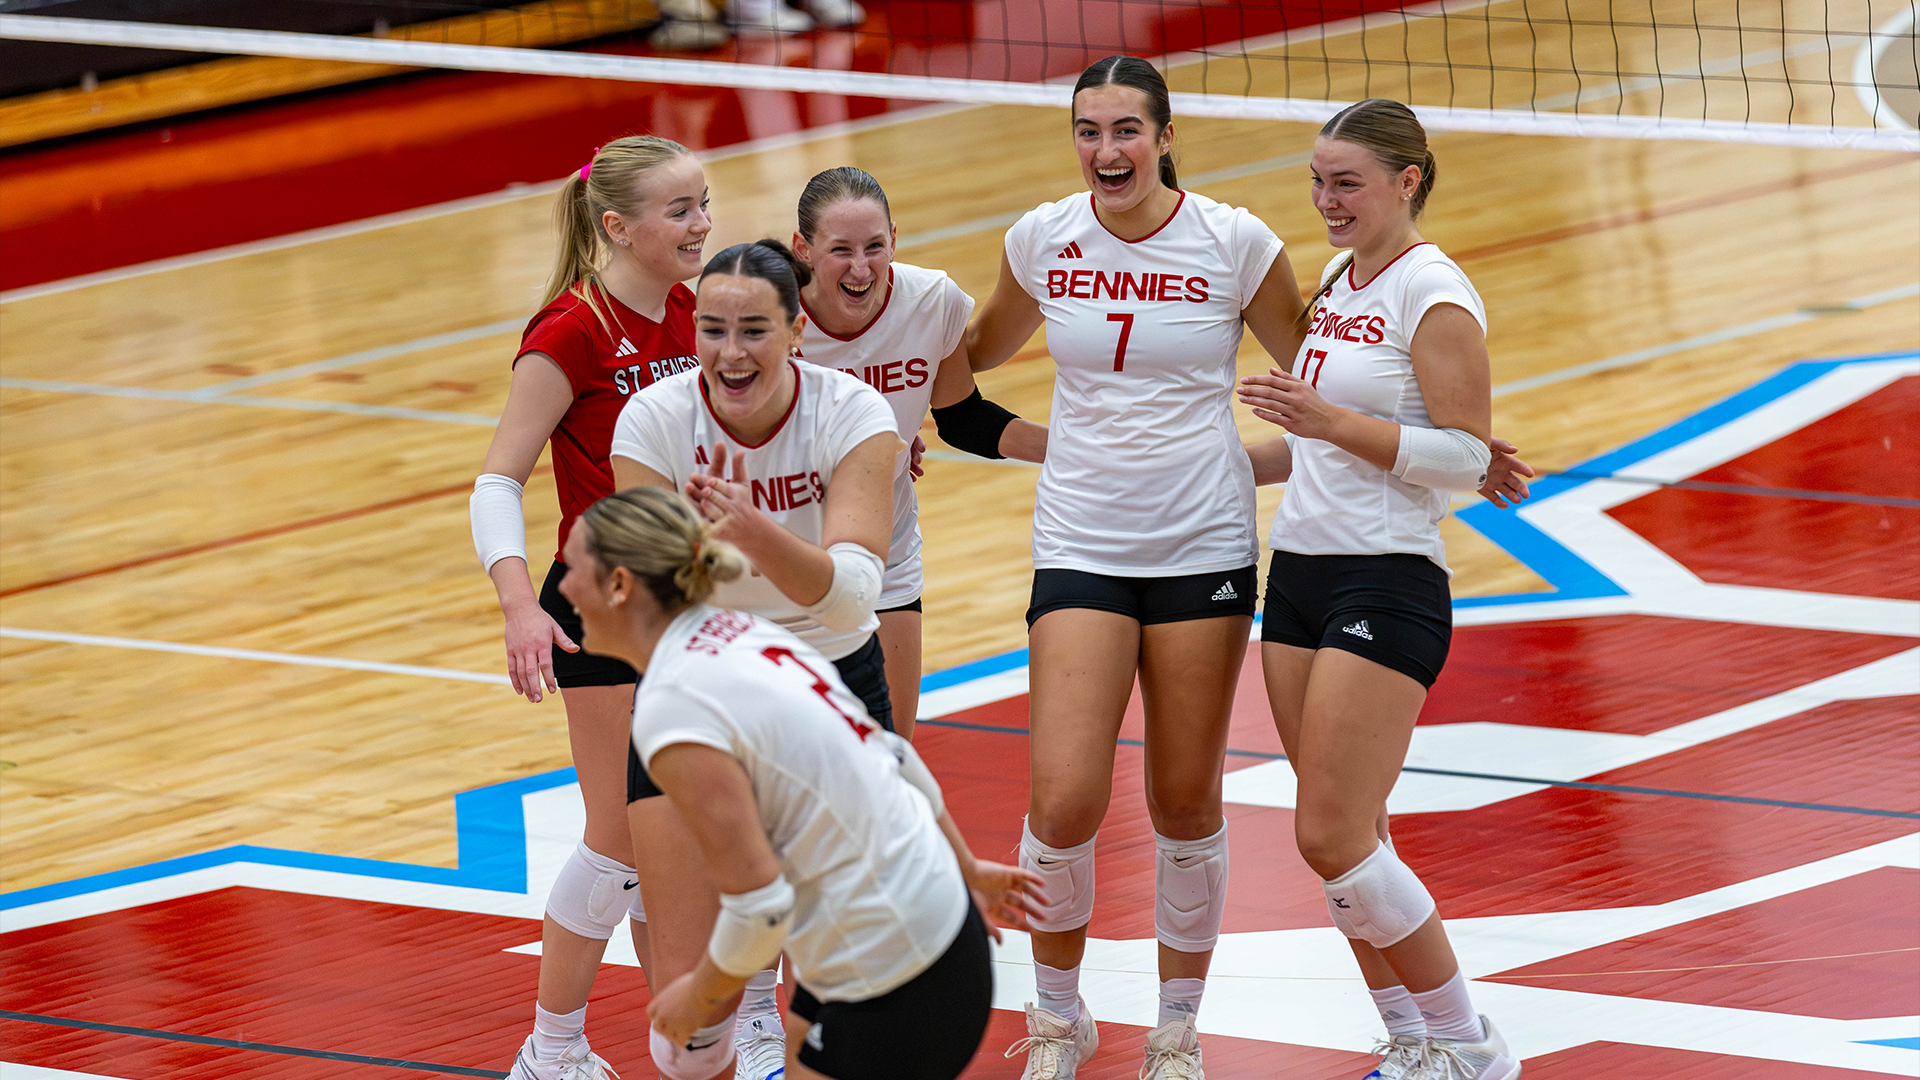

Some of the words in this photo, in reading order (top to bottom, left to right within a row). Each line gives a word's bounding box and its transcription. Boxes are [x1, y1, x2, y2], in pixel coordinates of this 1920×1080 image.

[1047, 269, 1209, 303] BENNIES
[1106, 313, 1135, 372] 7
[1307, 305, 1386, 344] ENNIES
[1300, 348, 1328, 391] 17
[750, 471, 825, 512] NIES
[1211, 592, 1238, 601] adidas
[1342, 624, 1374, 641] adidas
[760, 645, 874, 744] 2
